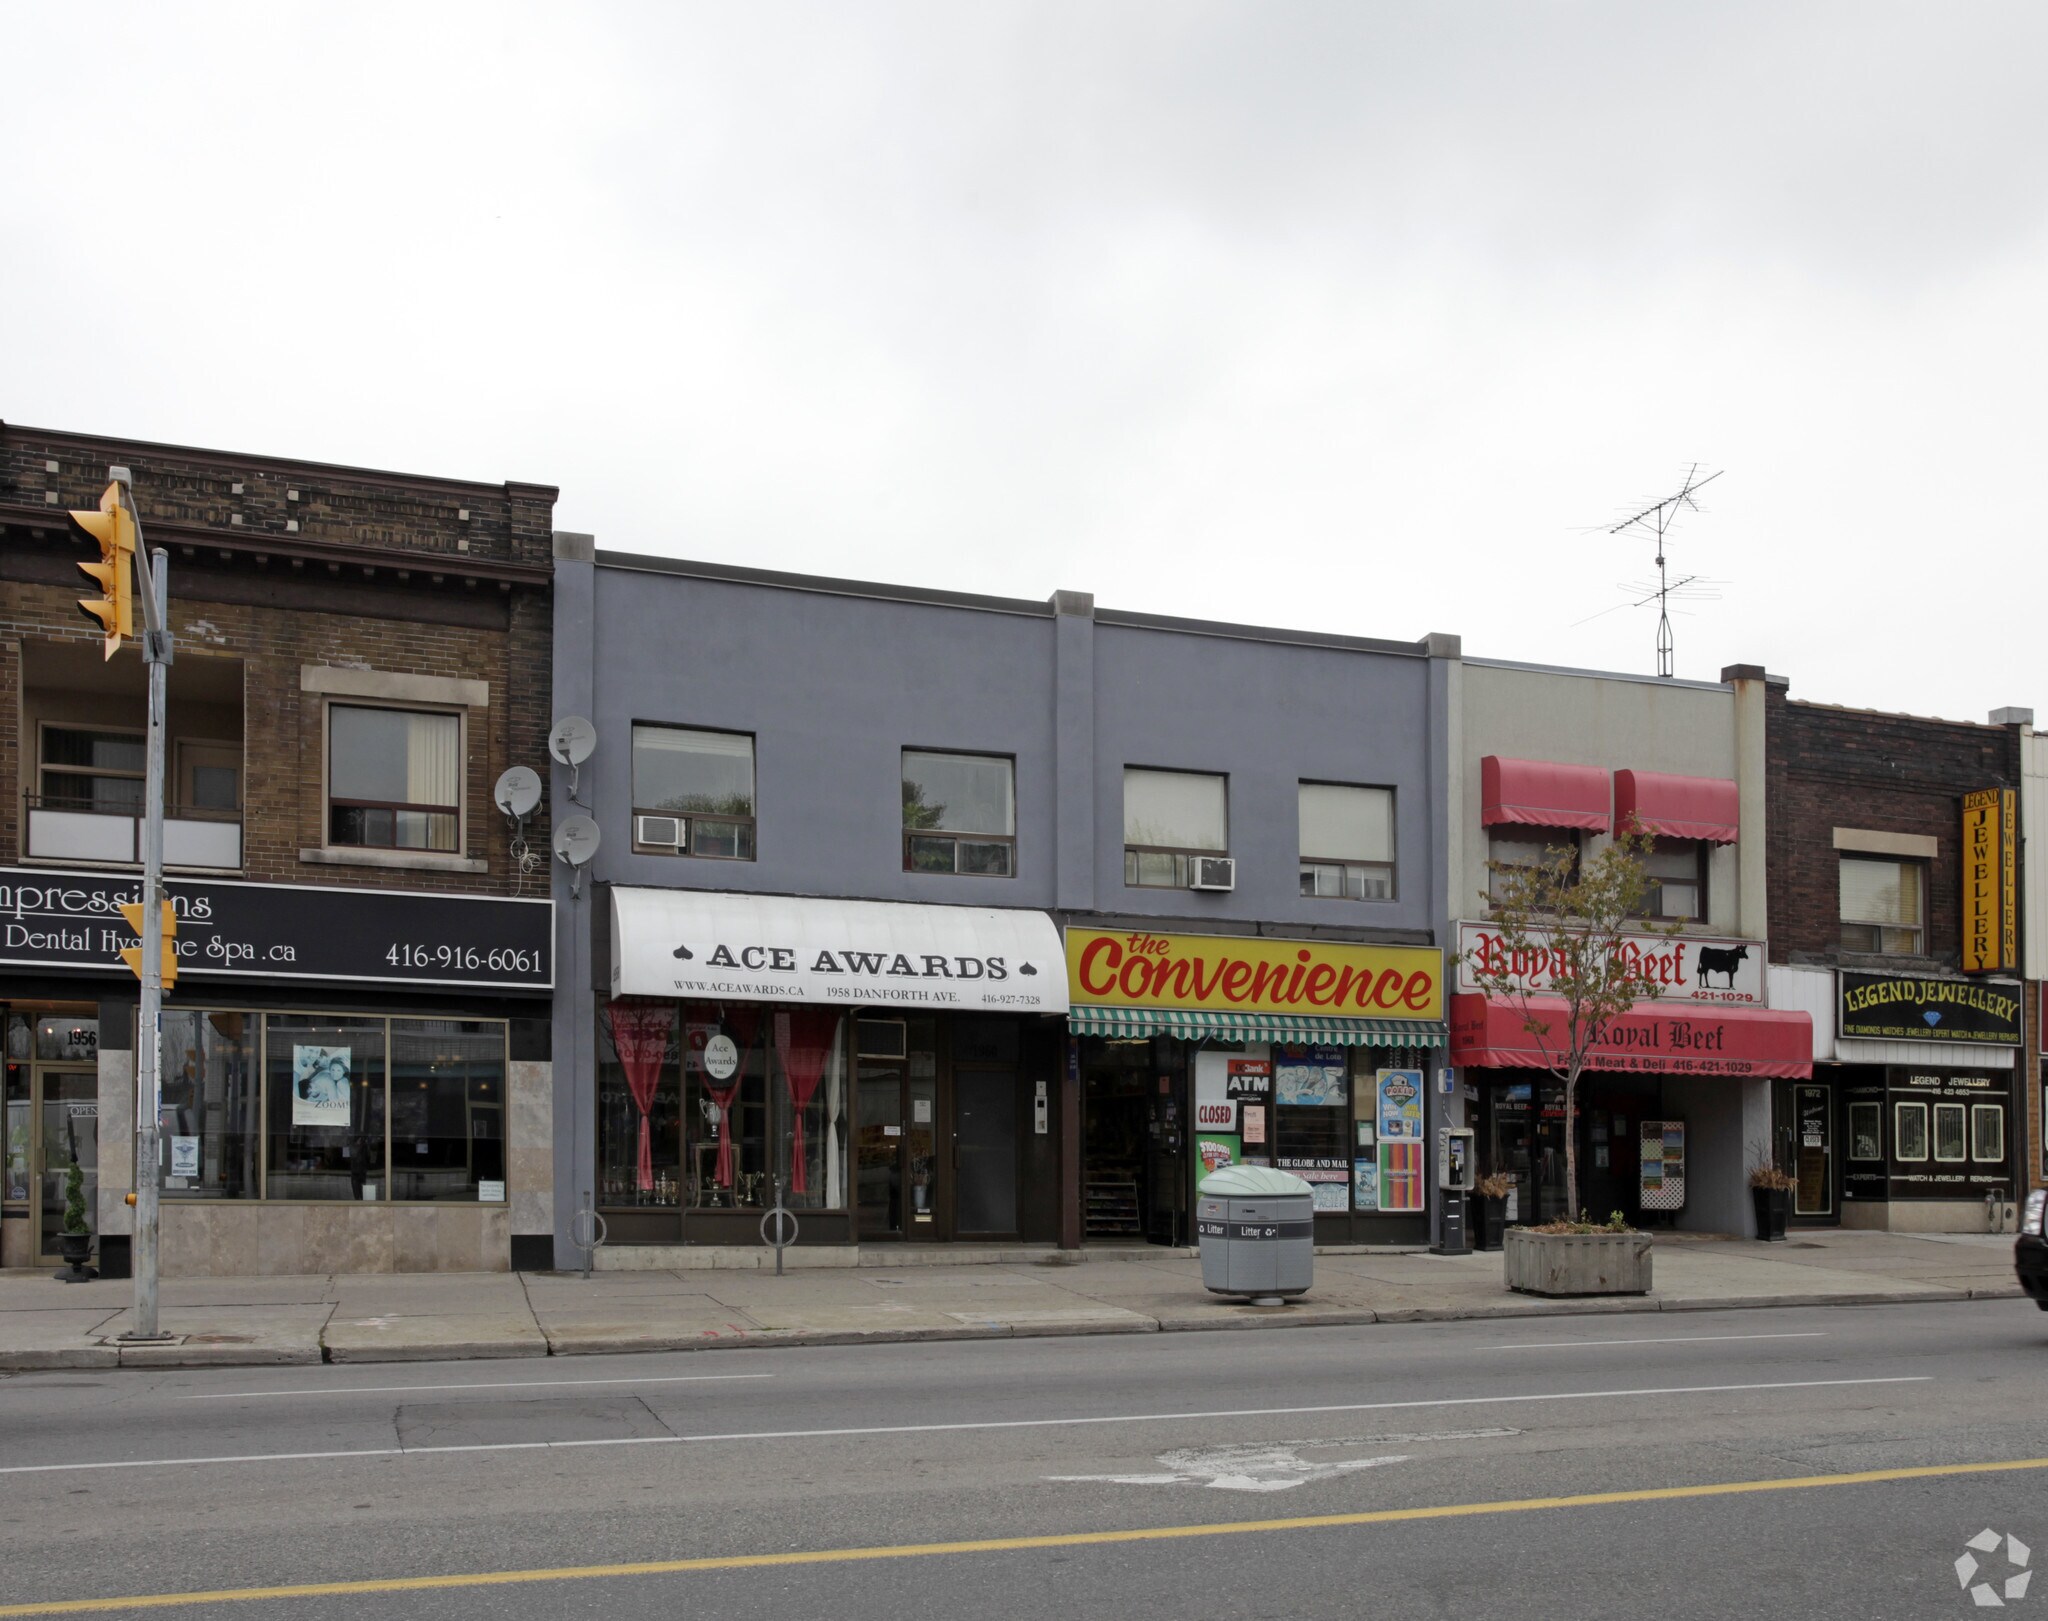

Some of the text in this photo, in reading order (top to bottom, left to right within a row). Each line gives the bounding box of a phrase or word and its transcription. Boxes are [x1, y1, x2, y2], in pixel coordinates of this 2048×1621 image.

[1963, 789, 1999, 809] LEGEND
[2004, 793, 2015, 965] JEWELLERY
[1973, 810, 1989, 969] JEWELLERY
[5, 924, 91, 951] Dental
[101, 930, 198, 960] Hyne
[206, 935, 255, 966] Spa
[1126, 931, 1170, 956] the
[385, 943, 542, 973] 416-916-6061
[705, 944, 1009, 981] ACE AWARDS
[1606, 941, 1687, 987] Beef
[1079, 937, 1433, 1011] Convenience
[674, 980, 805, 996] WWW.ACEAWARDS.CA
[826, 986, 961, 1002] 1958 DANFORTH AVE.
[981, 994, 1041, 1005] 416-927-7328
[1690, 990, 1753, 1003] 421-1029
[1845, 981, 2020, 1022] LEGEND JEWELLERY
[68, 1030, 96, 1045] 1956
[1588, 1019, 1725, 1052] Royal Beef
[1844, 1024, 1856, 1033] FINE
[1856, 1025, 1881, 1034] DIAMONDS
[1882, 1026, 1904, 1036] WATCHES
[1905, 1027, 1932, 1037] JEWELLERY
[1933, 1028, 1950, 1037] EXPERT
[1951, 1029, 1967, 1038] WATCH
[1972, 1030, 1998, 1041] JEWELLERY
[1999, 1032, 2019, 1042] REPAIRS
[712, 1044, 729, 1052] Ace
[705, 1057, 736, 1065] Awards
[1557, 1054, 1591, 1067] Frh
[1595, 1056, 1625, 1068] Meat
[1629, 1057, 1638, 1068] &
[1643, 1057, 1666, 1070] Deli
[1228, 1076, 1270, 1092] ATM
[1910, 1076, 1991, 1086] LEGEND JEWELLERY
[1804, 1088, 1821, 1097] 1972
[70, 1106, 98, 1115] OPEN
[314, 1099, 351, 1110] ZOOM!
[1495, 1102, 1528, 1111] ROYAL BEEF
[1545, 1103, 1562, 1111] ROYAL
[1199, 1105, 1231, 1124] CLOSED
[1277, 1158, 1291, 1167] THE
[1292, 1159, 1314, 1168] GLOBE
[1315, 1159, 1330, 1168] AND
[1332, 1160, 1348, 1168] MAIL
[1302, 1172, 1319, 1180] Sale
[1320, 1171, 1338, 1180] here
[1207, 1221, 1223, 1234] Litter
[1241, 1226, 1260, 1237] Litter
